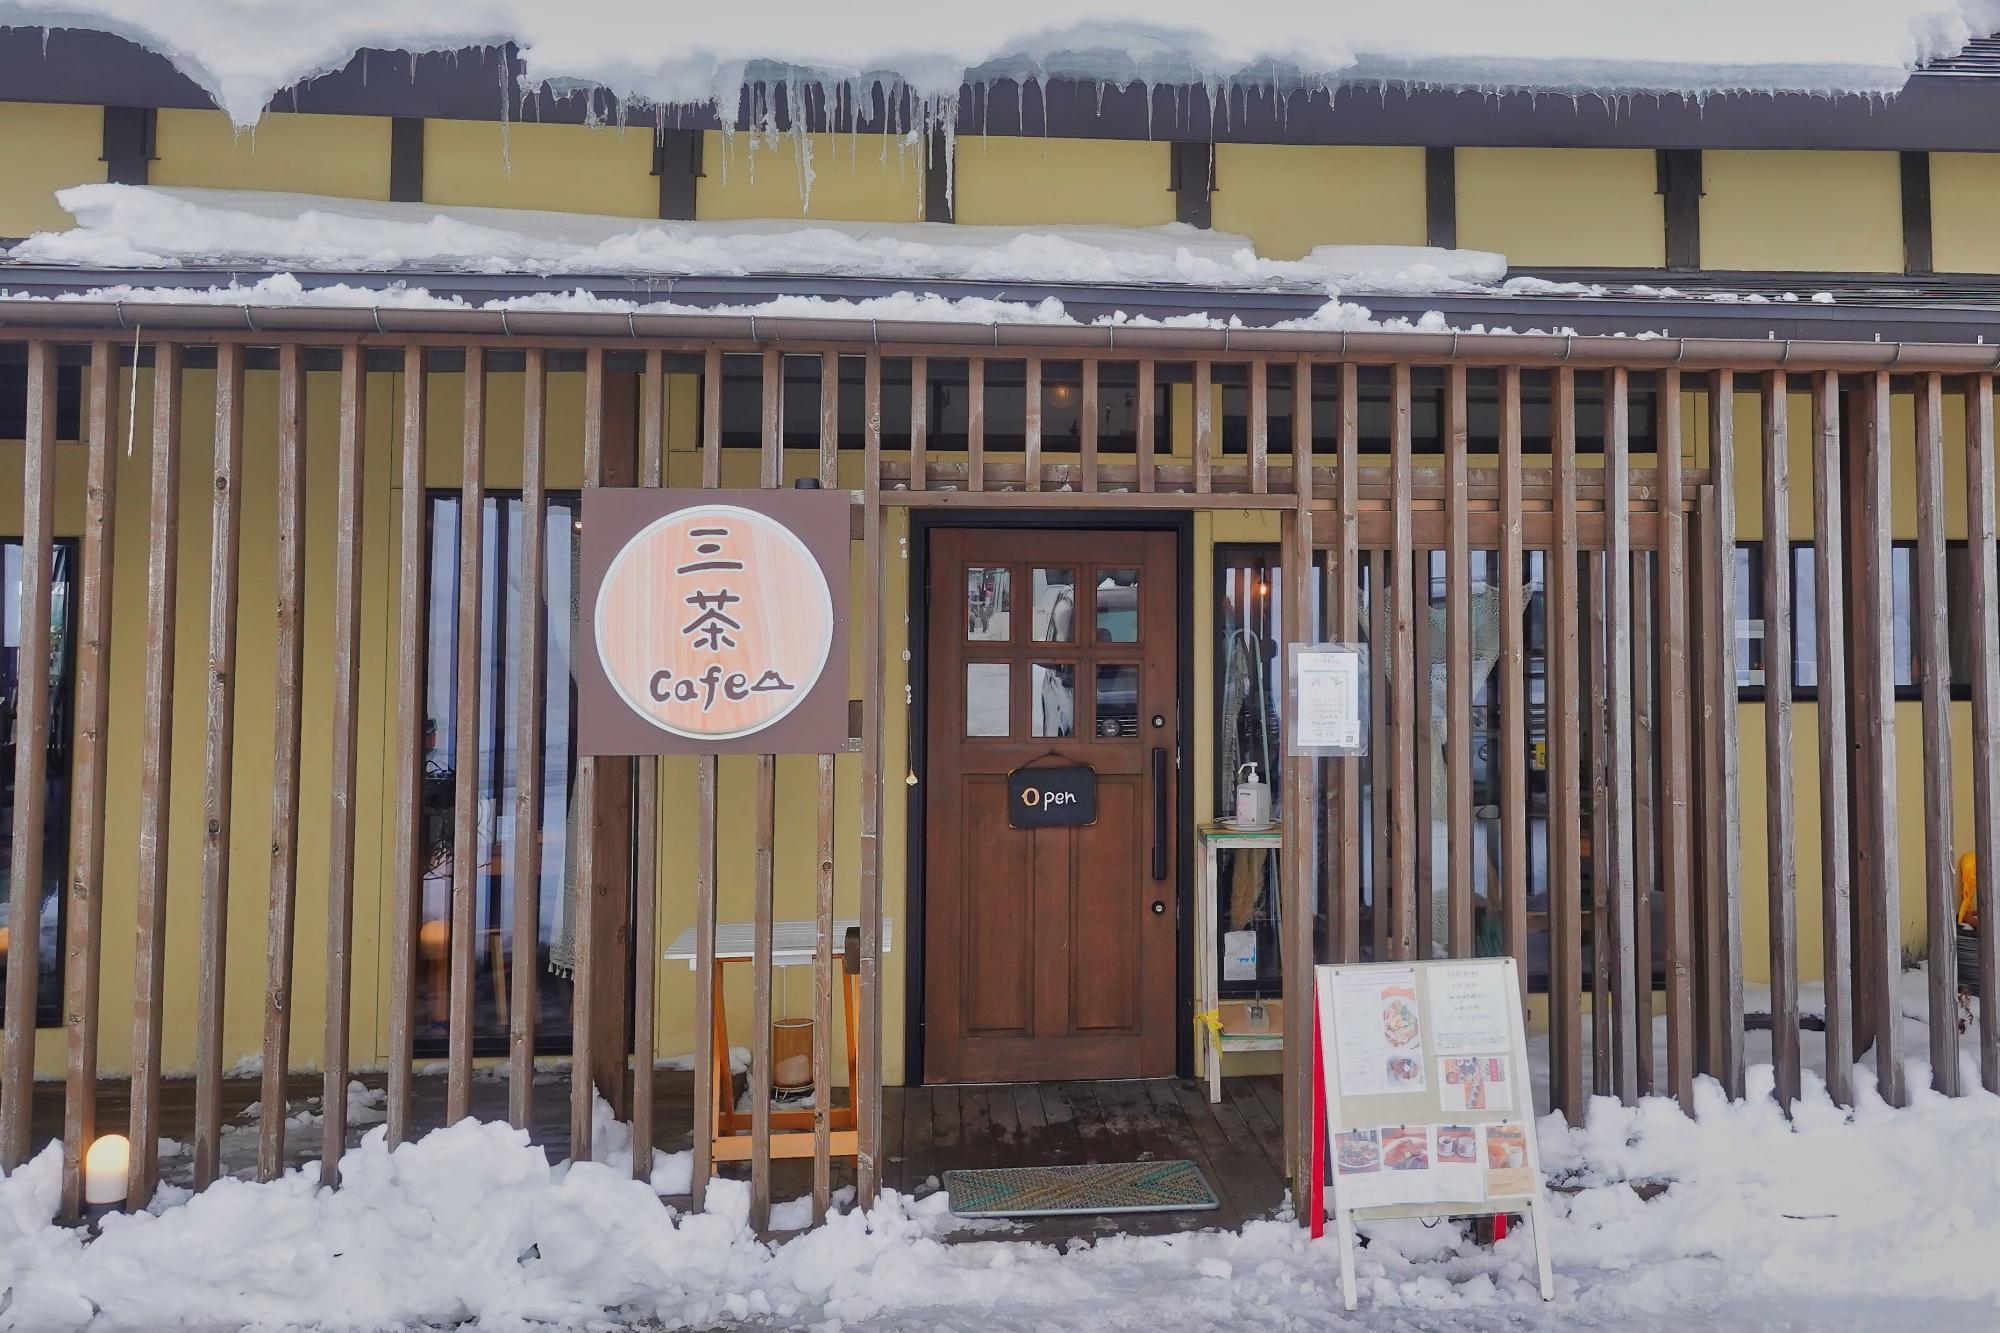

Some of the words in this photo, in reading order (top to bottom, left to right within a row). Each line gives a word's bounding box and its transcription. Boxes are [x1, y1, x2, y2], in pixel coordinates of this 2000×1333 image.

[677, 529, 743, 650] 三茶
[649, 666, 749, 712] Cafe
[1021, 787, 1077, 811] Open
